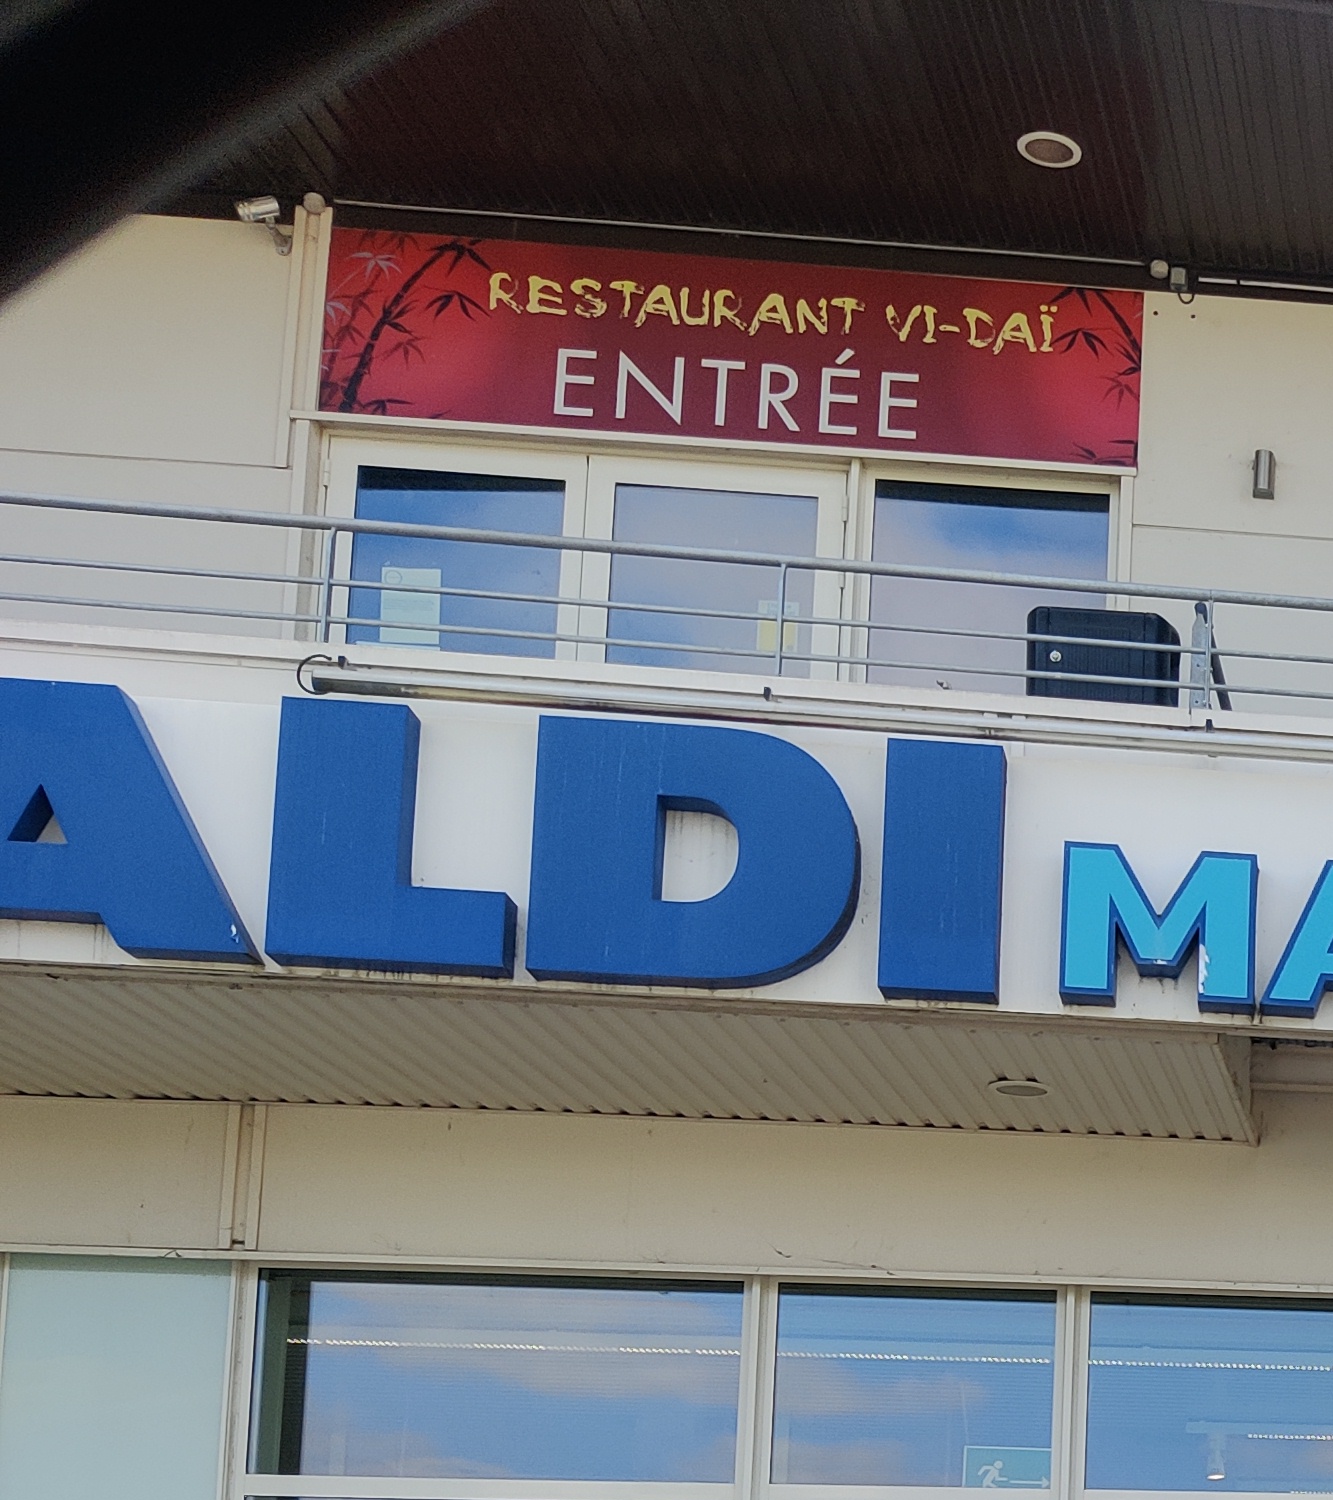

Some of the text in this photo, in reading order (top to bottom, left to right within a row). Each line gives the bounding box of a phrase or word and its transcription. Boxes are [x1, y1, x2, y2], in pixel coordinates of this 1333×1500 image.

[489, 272, 1058, 356] RESTAURANT VI-DAÏ
[553, 347, 920, 441] ENTRÉE
[0, 677, 1007, 1005] ALDI
